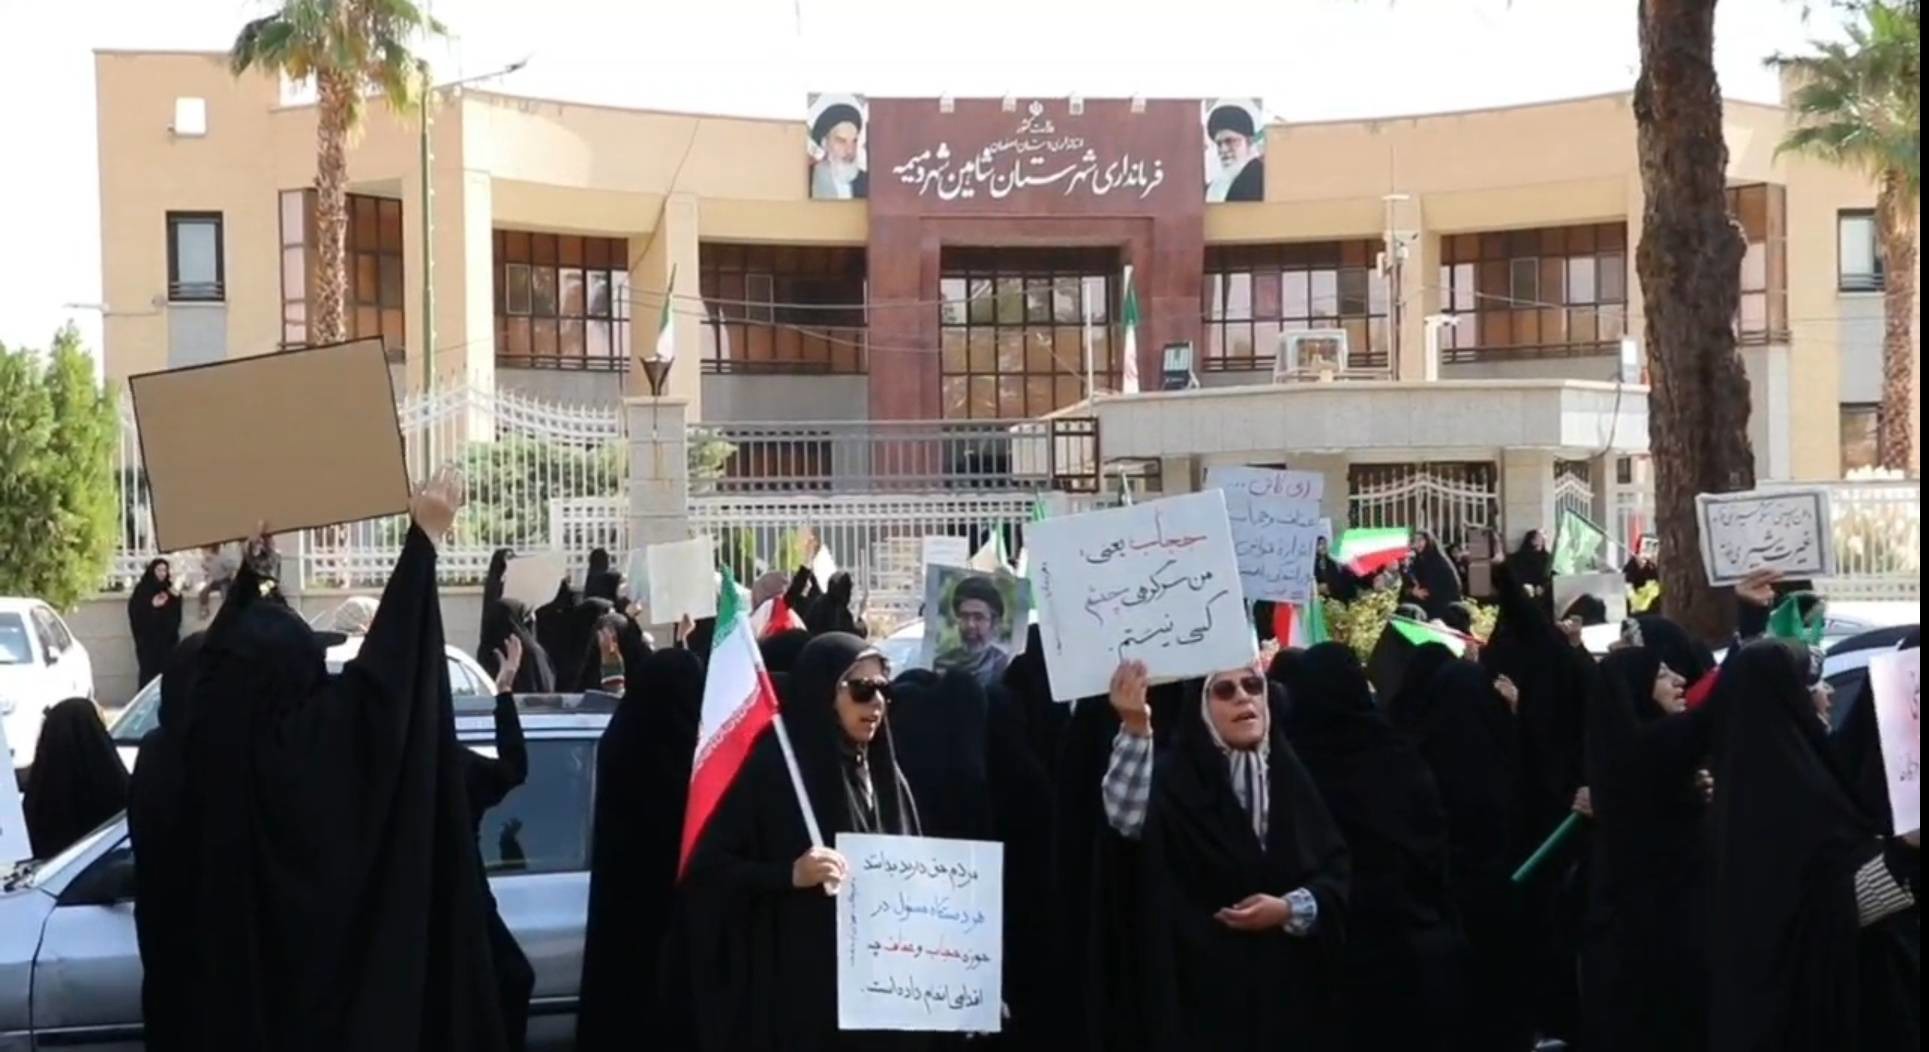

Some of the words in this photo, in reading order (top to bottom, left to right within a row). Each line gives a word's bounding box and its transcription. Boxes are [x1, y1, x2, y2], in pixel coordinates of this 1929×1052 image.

[937, 147, 995, 200] شاهین
[990, 148, 1098, 198] شهرستان
[1091, 153, 1164, 199] فرمانداری
[1130, 509, 1208, 556] حجاب
[1187, 571, 1213, 592] من
[1176, 589, 1230, 646] کسی
